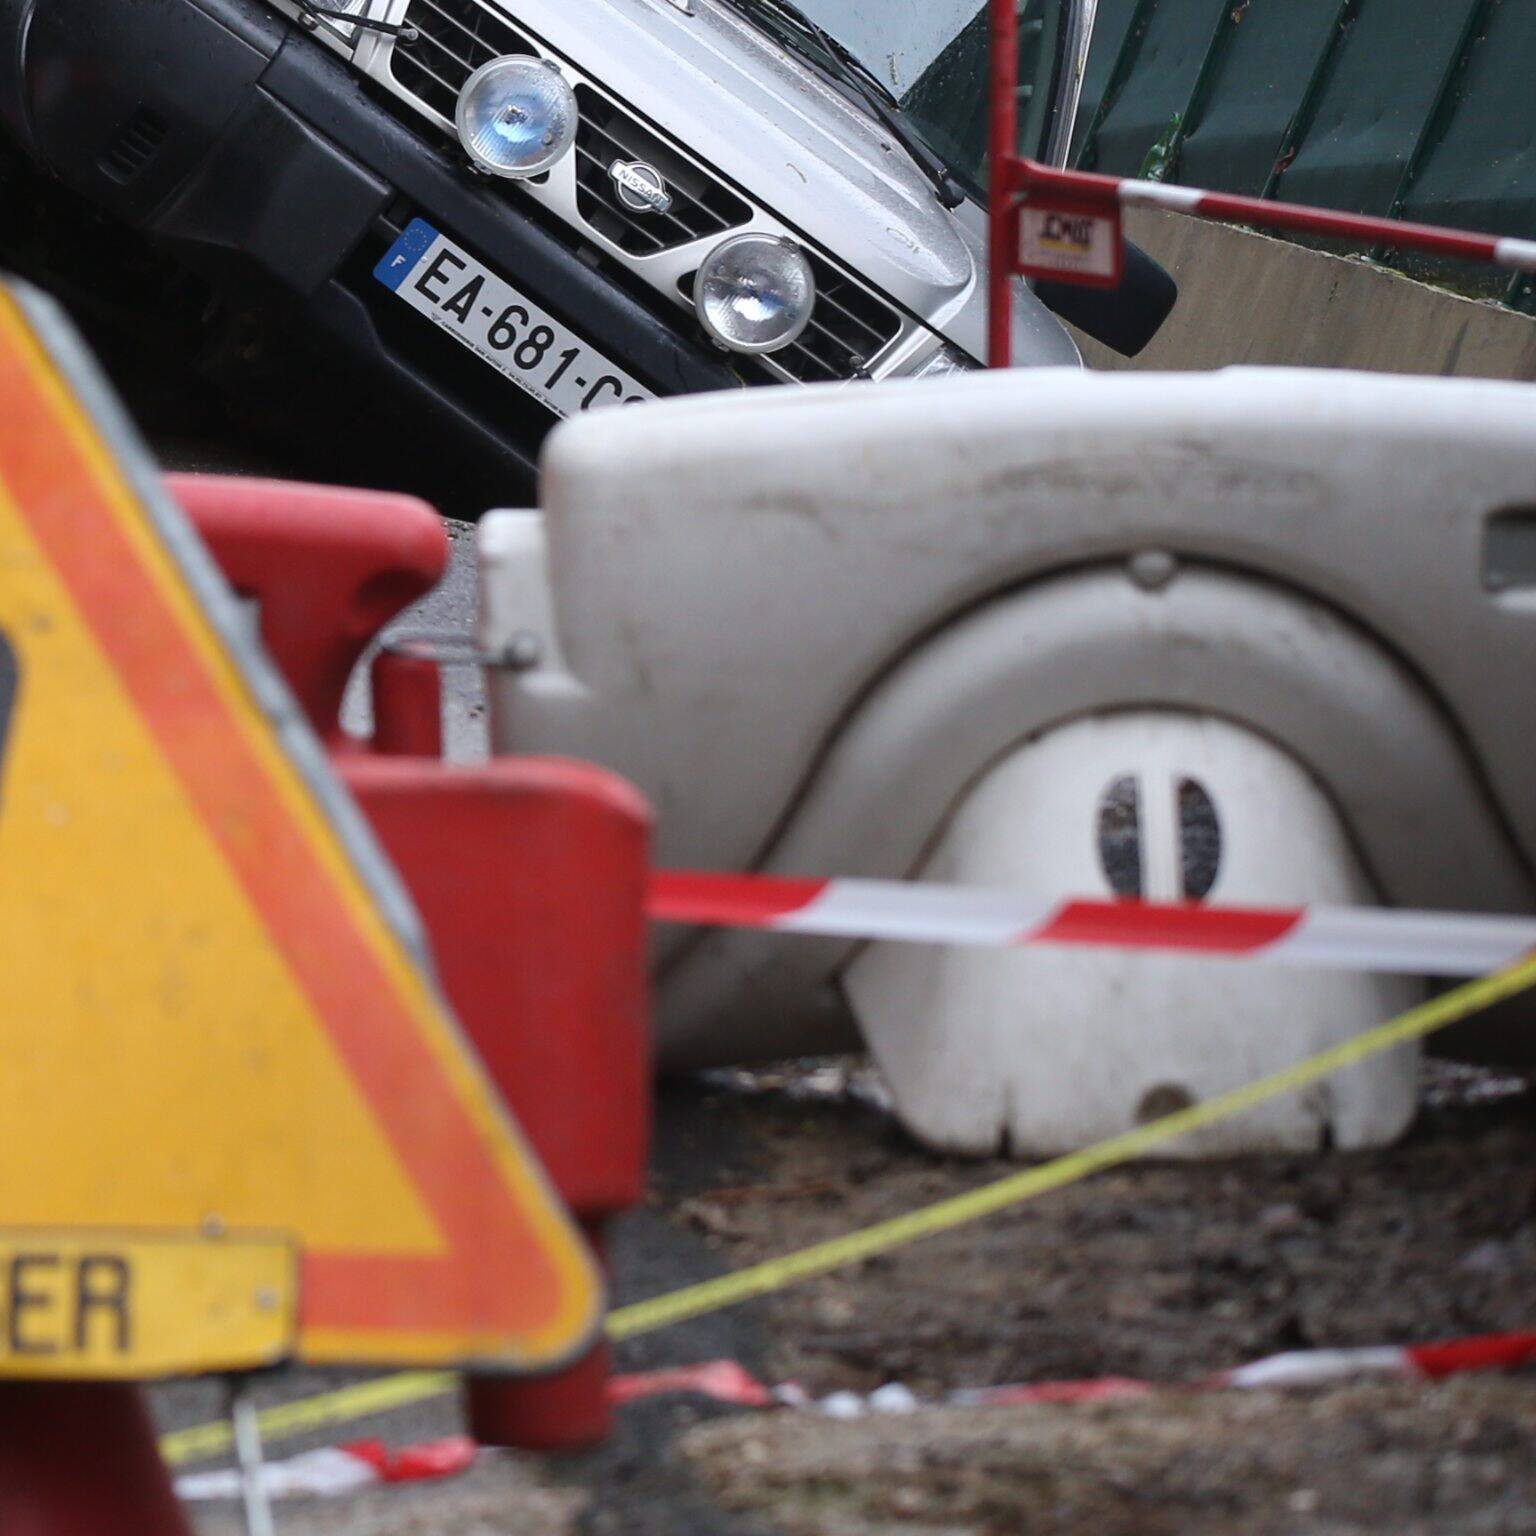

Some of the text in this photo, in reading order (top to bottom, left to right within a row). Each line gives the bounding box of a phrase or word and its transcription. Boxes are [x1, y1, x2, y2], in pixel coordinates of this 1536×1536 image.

[619, 170, 664, 205] NISSAN
[390, 254, 406, 268] F
[413, 248, 647, 412] EA-681-C
